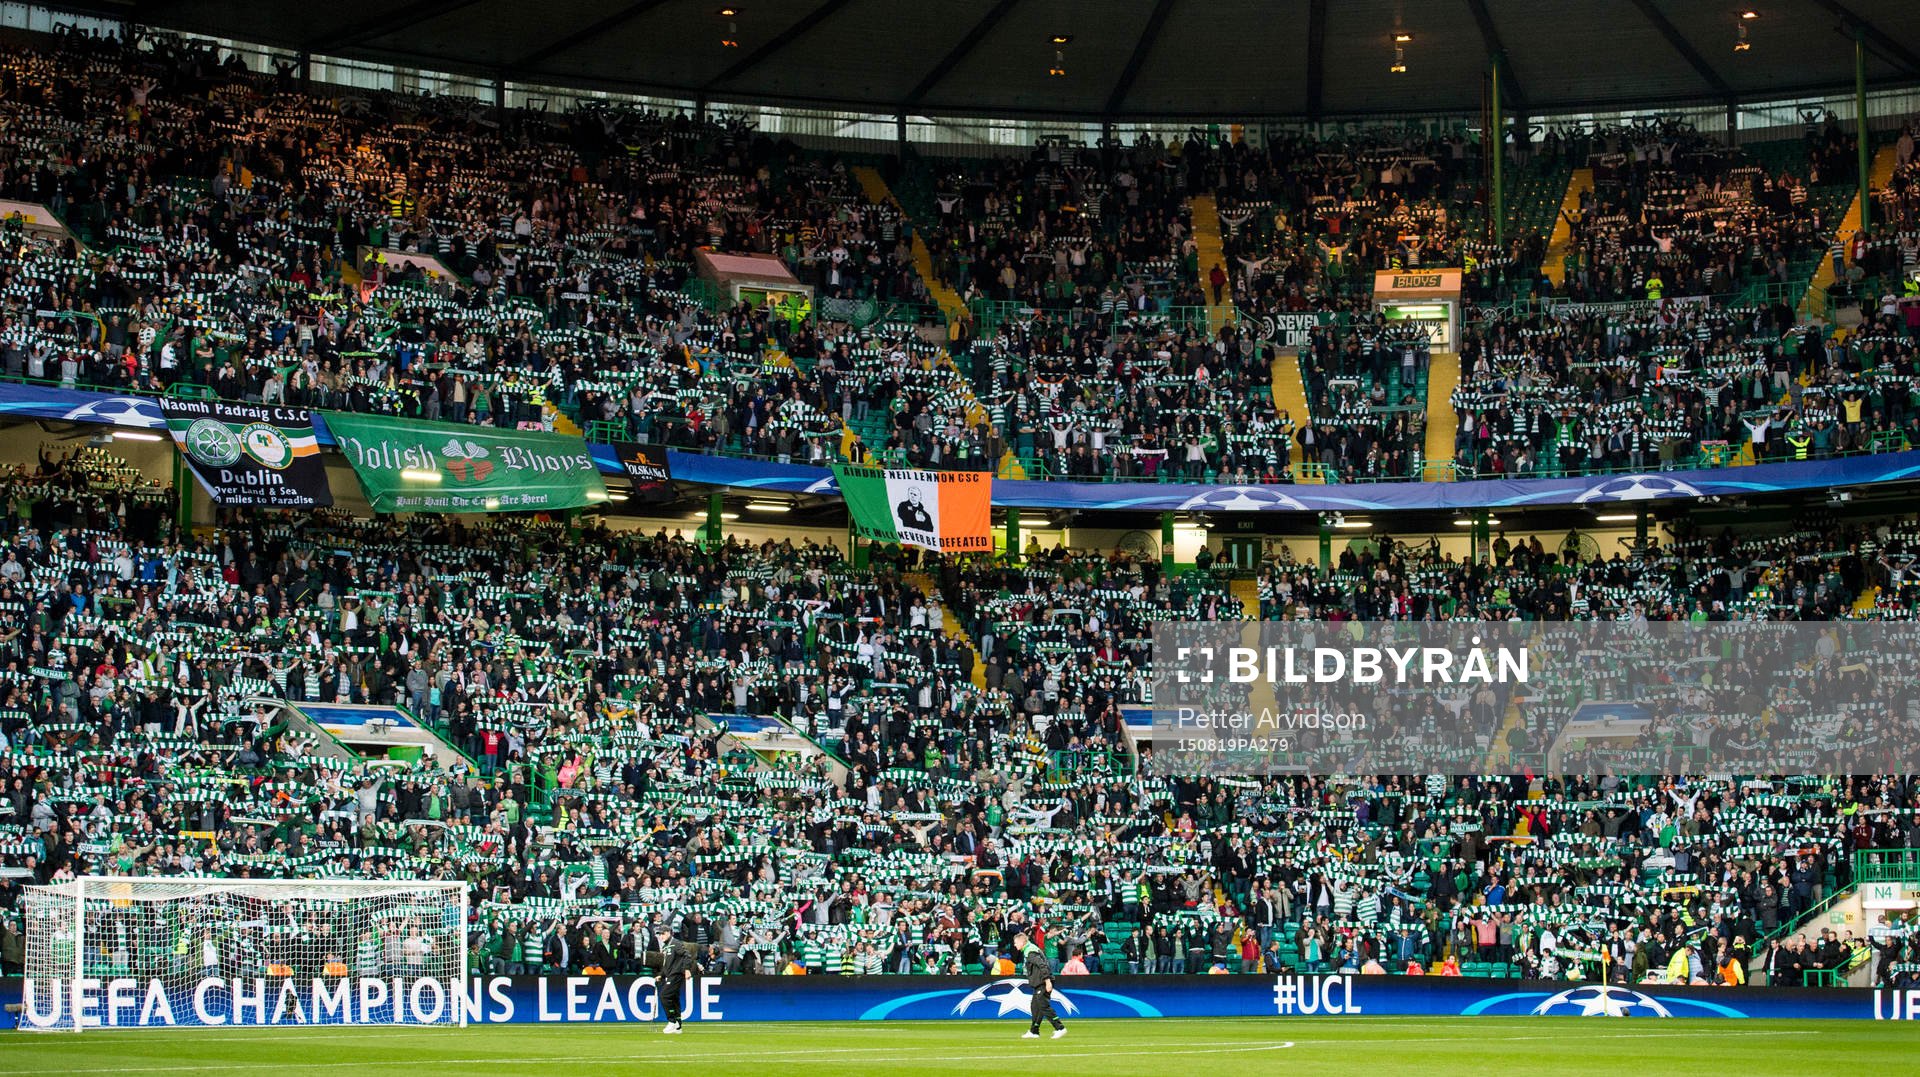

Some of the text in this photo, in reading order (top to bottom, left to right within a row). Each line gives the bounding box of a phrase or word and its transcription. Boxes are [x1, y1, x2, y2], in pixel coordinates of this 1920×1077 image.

[1397, 275, 1439, 287] BHOYS
[1286, 330, 1312, 346] ONE
[160, 398, 209, 414] Naomh
[216, 404, 268, 421] Padraig
[496, 445, 593, 475] Bhoys
[221, 470, 284, 486] Dublin
[889, 470, 912, 480] NEIL
[915, 472, 955, 483] LENNON
[958, 473, 979, 482] CSC
[241, 486, 264, 496] Land
[269, 487, 276, 496] &
[280, 487, 298, 495] Sea
[226, 495, 252, 504] miles
[257, 496, 267, 504] to
[271, 496, 314, 504] Paradise
[452, 496, 469, 507] The
[501, 494, 518, 505] Are
[521, 494, 548, 505] Here!
[1237, 521, 1254, 529] EXIT
[873, 527, 897, 540] WILL
[898, 531, 926, 543] NEVER
[926, 536, 937, 547] BE
[939, 537, 988, 548] DEFEATED
[1875, 886, 1892, 899] N4
[25, 977, 175, 1027] UEFA
[194, 976, 514, 1025] CHAMPIONS
[1273, 975, 1362, 1015] #UCL
